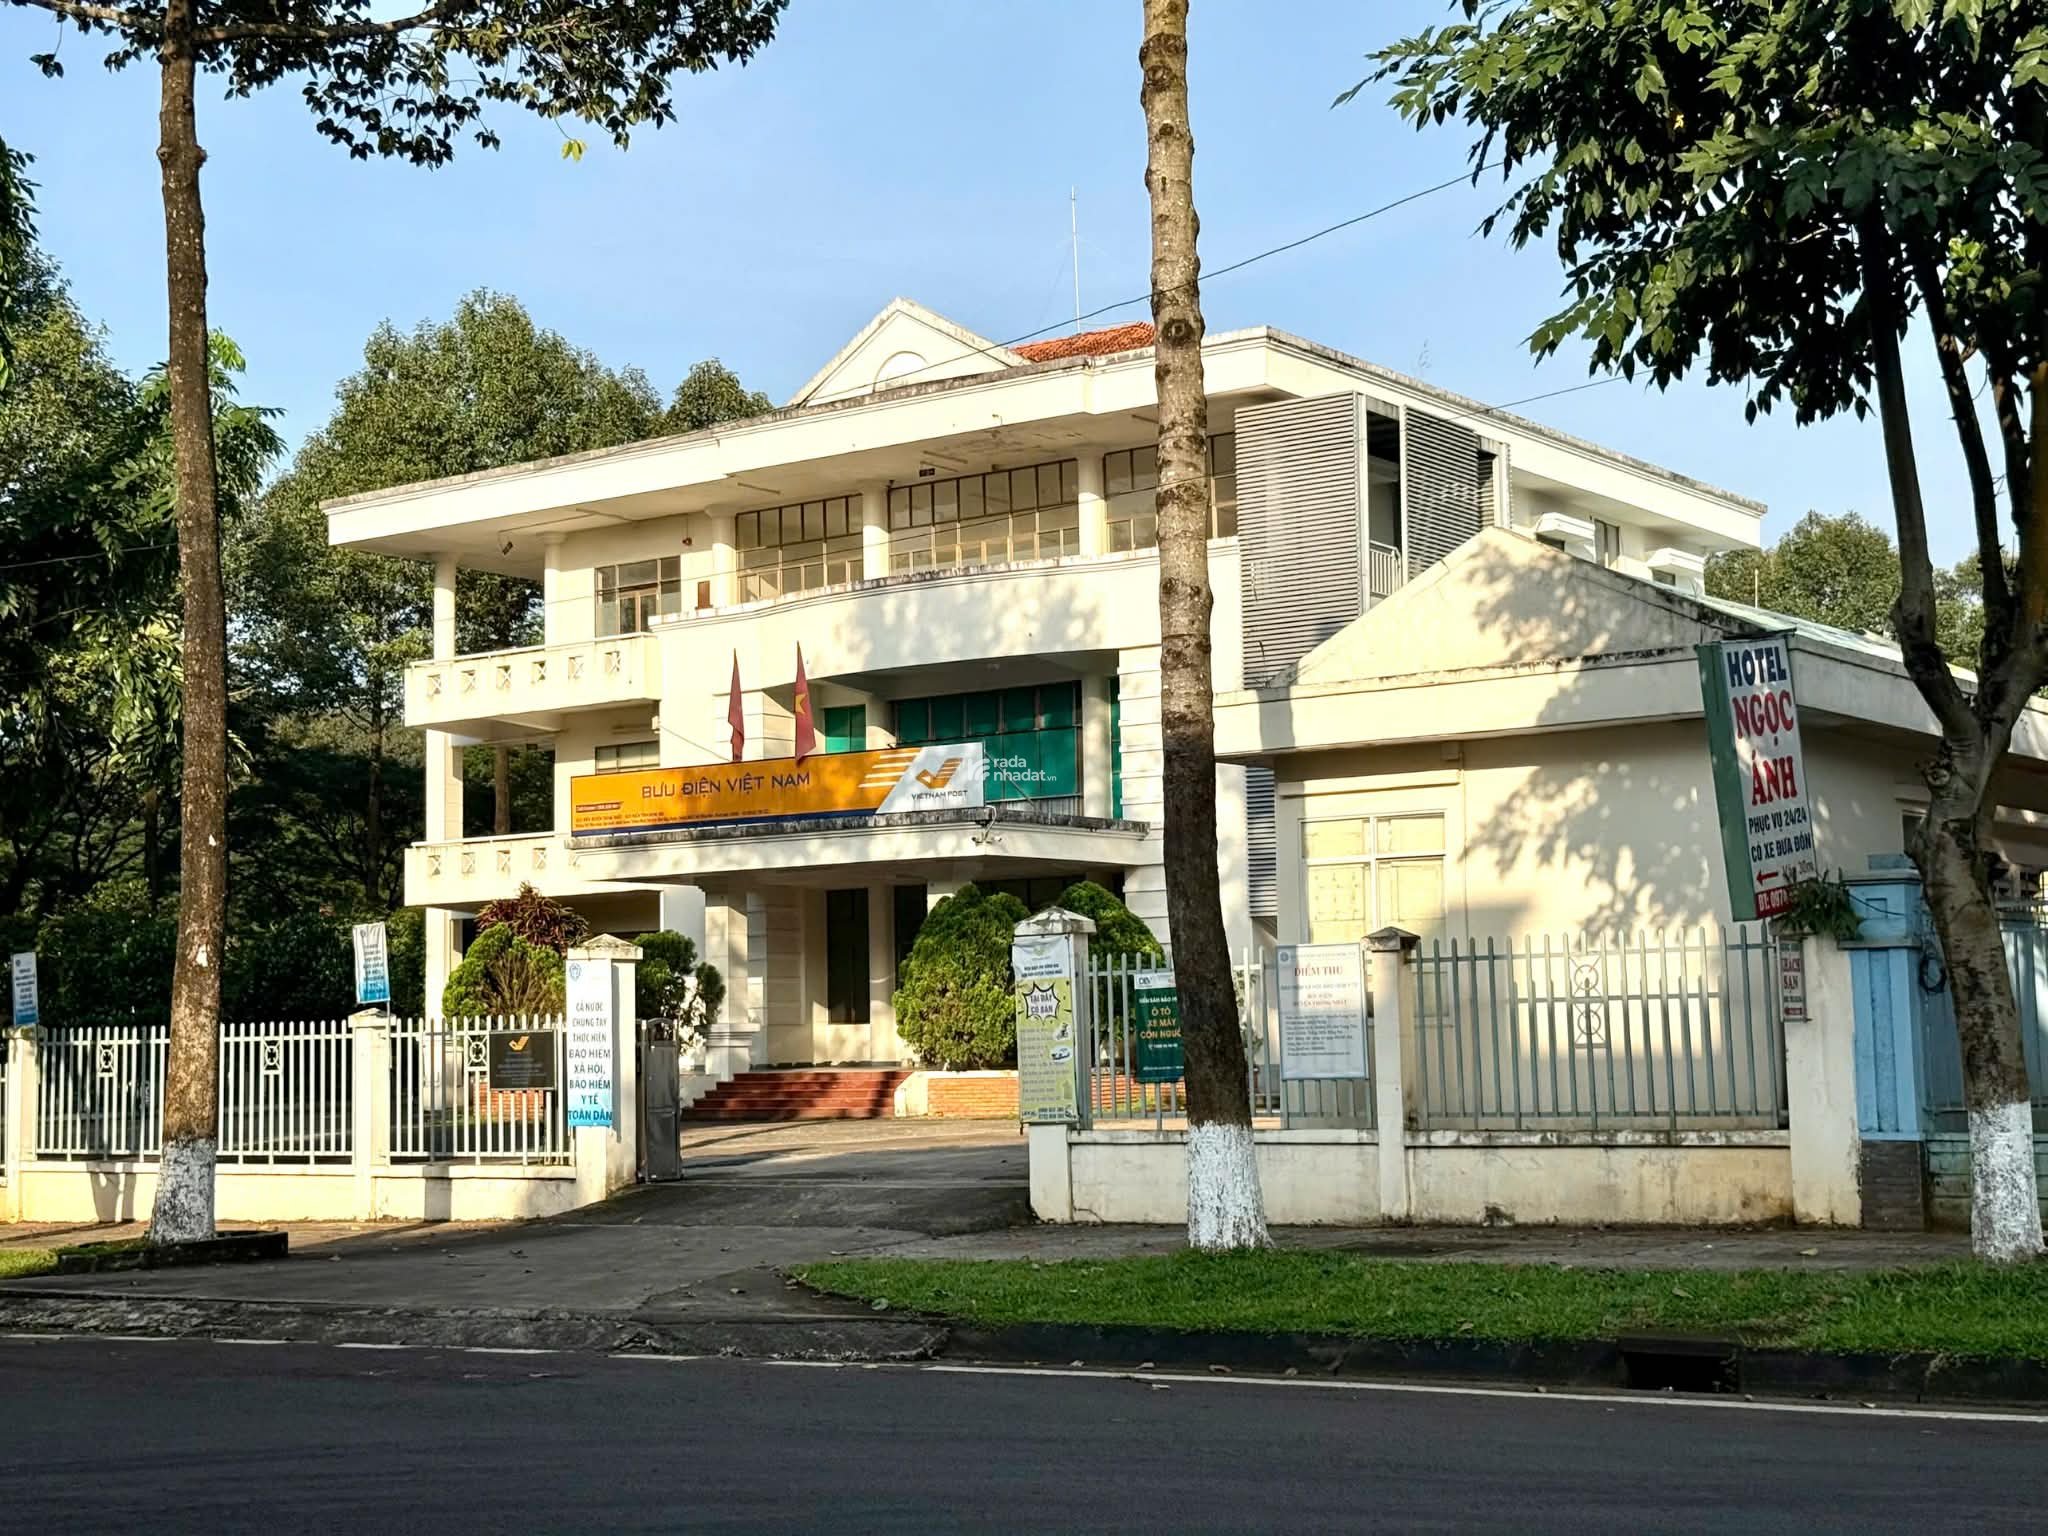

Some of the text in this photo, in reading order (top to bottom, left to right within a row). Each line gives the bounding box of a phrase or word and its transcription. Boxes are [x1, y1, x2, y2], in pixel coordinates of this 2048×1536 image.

[1727, 646, 1787, 688] HOTEL
[1732, 690, 1794, 746] NGỌC
[681, 777, 721, 797] ĐIỆN
[726, 772, 764, 794] VIỆT
[771, 772, 810, 788] NAM
[1751, 749, 1797, 806] ÁNH
[911, 789, 968, 800] VIETNAM POST
[1748, 806, 1807, 836] PHỤC VỤ 24/24
[1751, 832, 1812, 862] CÓ XE ĐƯA ĐÓN
[569, 1076, 611, 1089] BẢO HIỂM
[581, 1093, 598, 1104] Y TẾ
[568, 1108, 613, 1121] TOÀN DÂN
